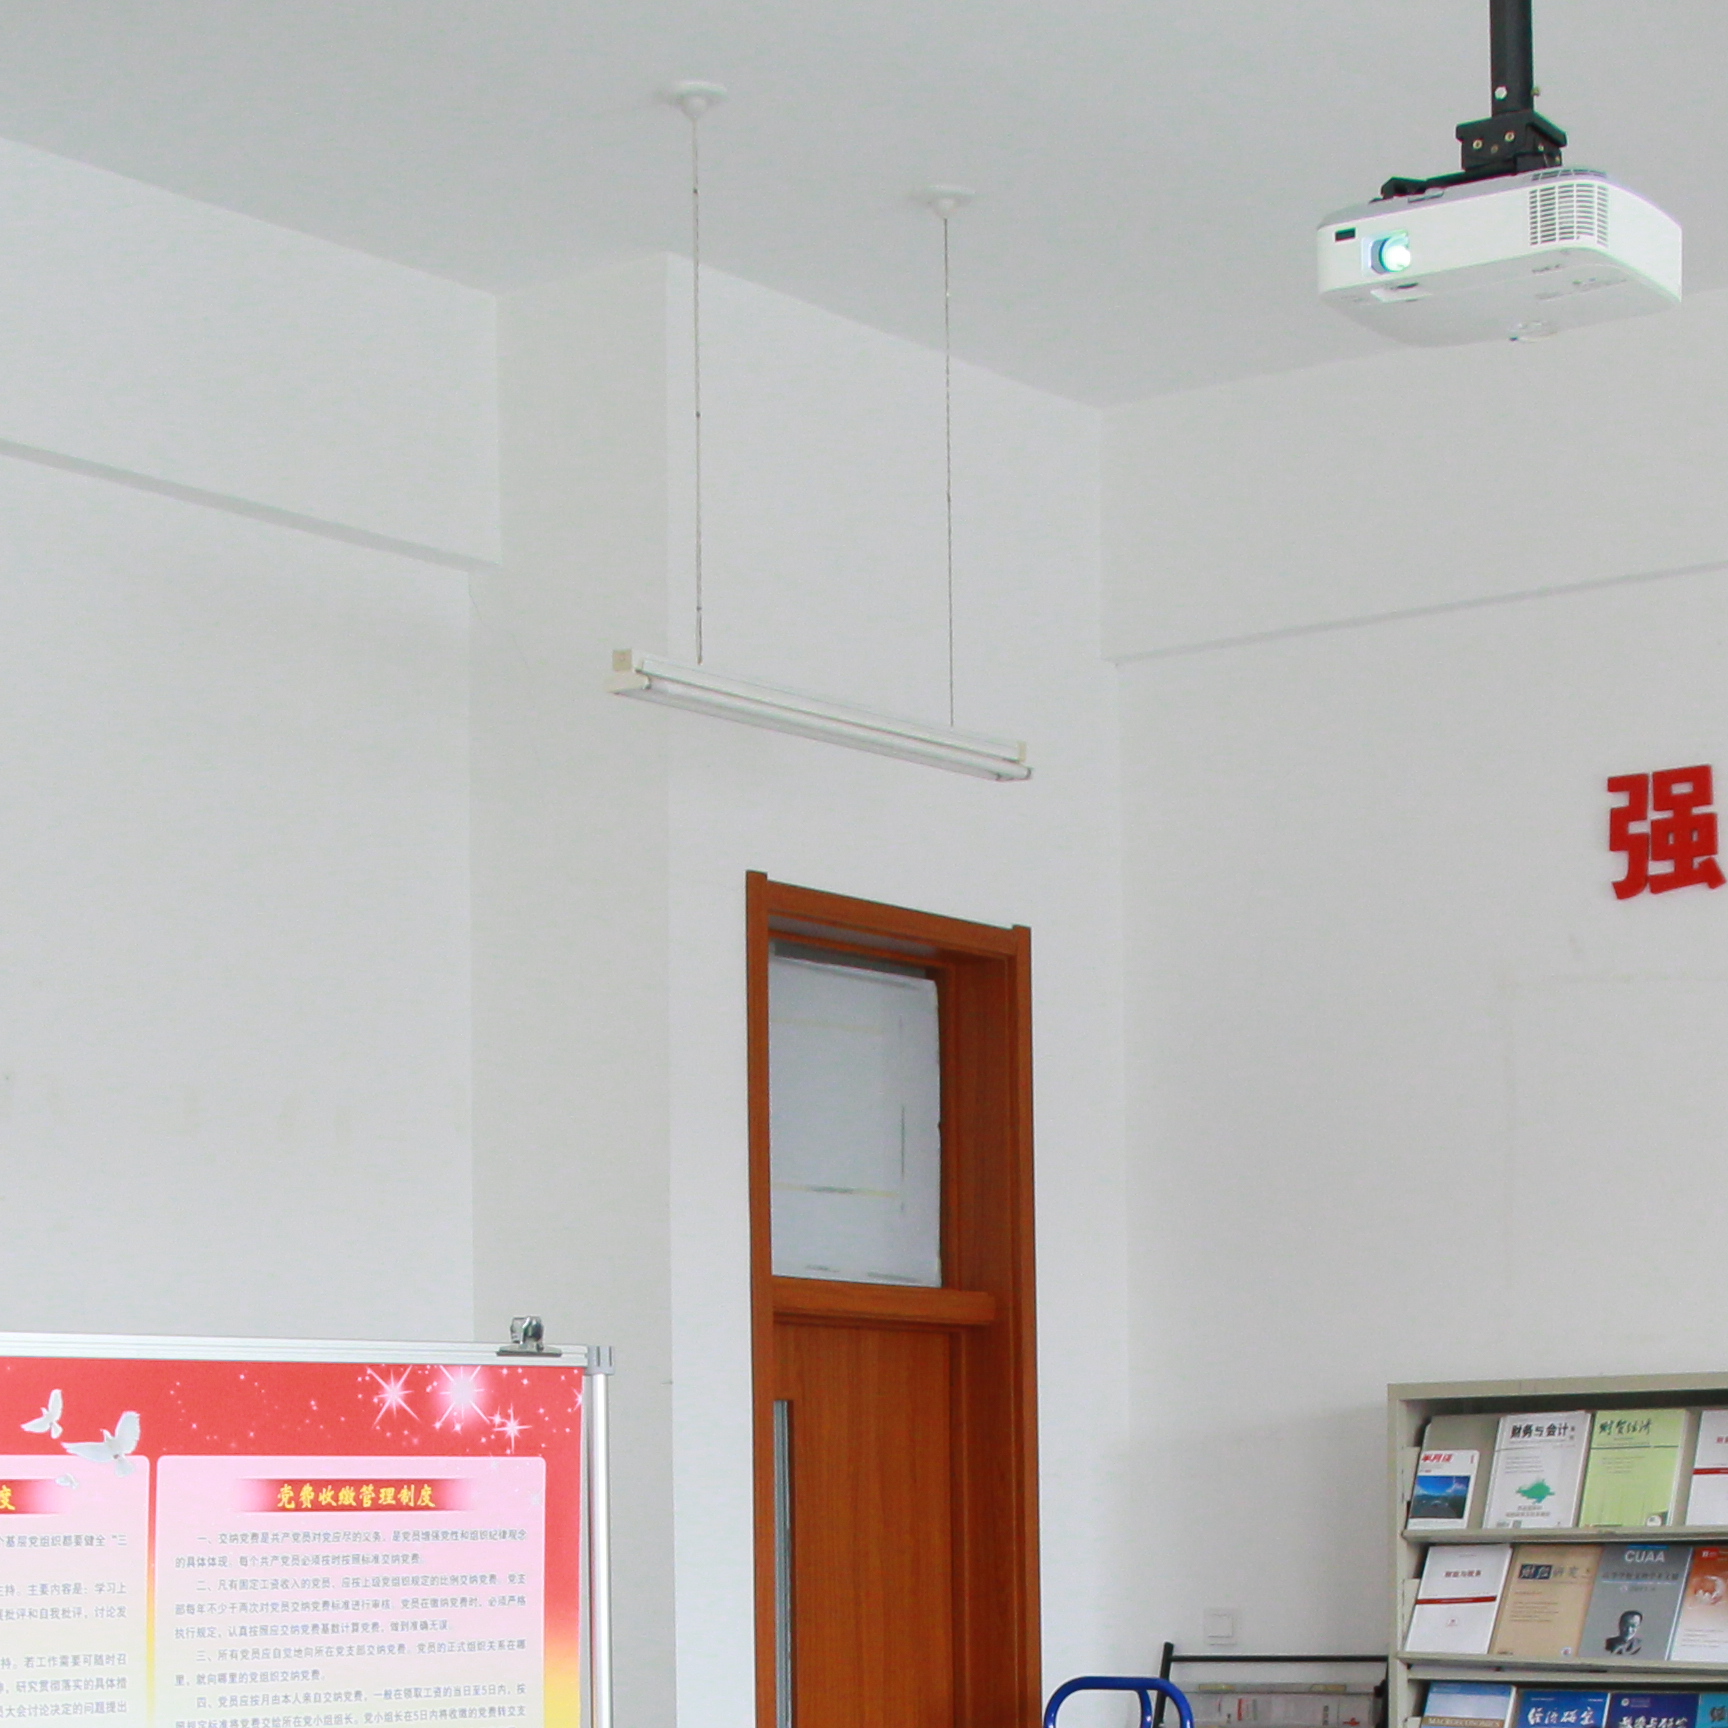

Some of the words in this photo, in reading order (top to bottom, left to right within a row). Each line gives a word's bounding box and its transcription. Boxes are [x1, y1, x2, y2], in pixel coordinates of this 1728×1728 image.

[1510, 1422, 1569, 1439] 财务与会计
[276, 1482, 437, 1510] 党费收缴管理制度
[1625, 1550, 1666, 1564] CUAA
[1528, 1706, 1595, 1726] 经济研究
